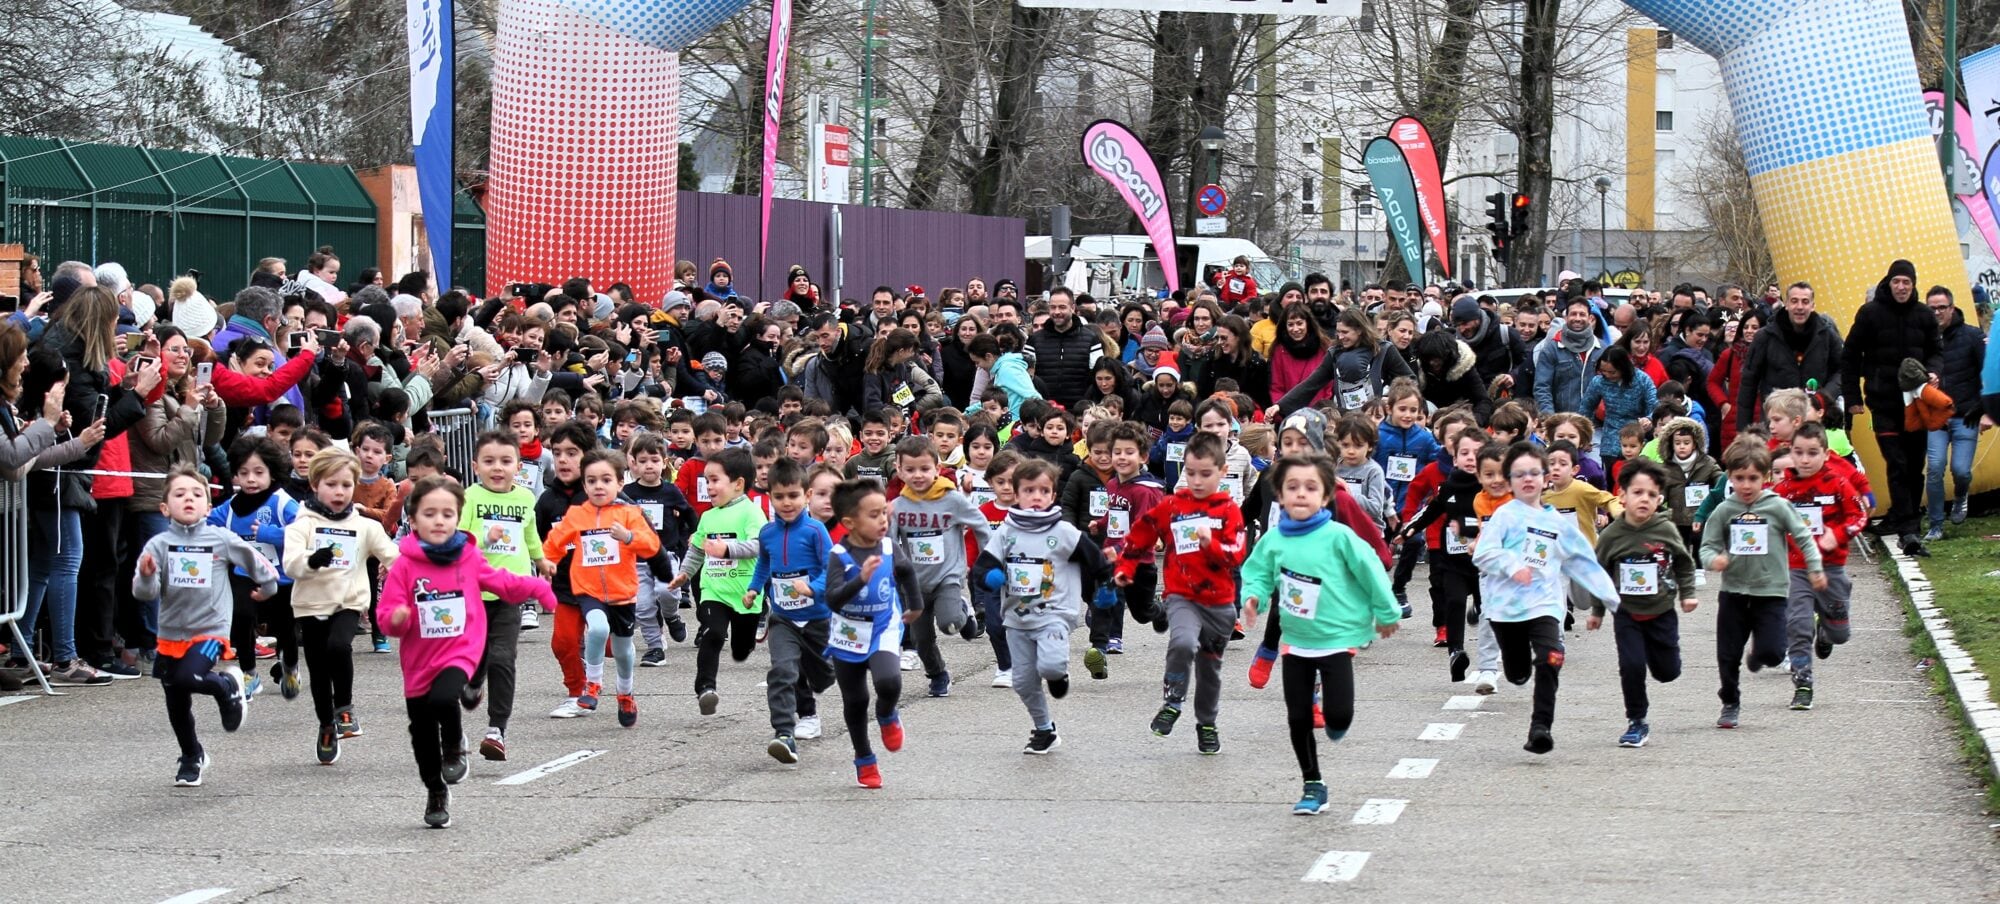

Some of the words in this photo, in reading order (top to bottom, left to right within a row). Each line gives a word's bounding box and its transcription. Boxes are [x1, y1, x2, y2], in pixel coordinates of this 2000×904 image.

[476, 504, 528, 520] EXPLORE
[897, 511, 953, 528] GREAT
[490, 544, 510, 552] IATC
[587, 556, 607, 564] FIATC
[426, 626, 453, 634] FIATC
[833, 637, 856, 648] FIATC
